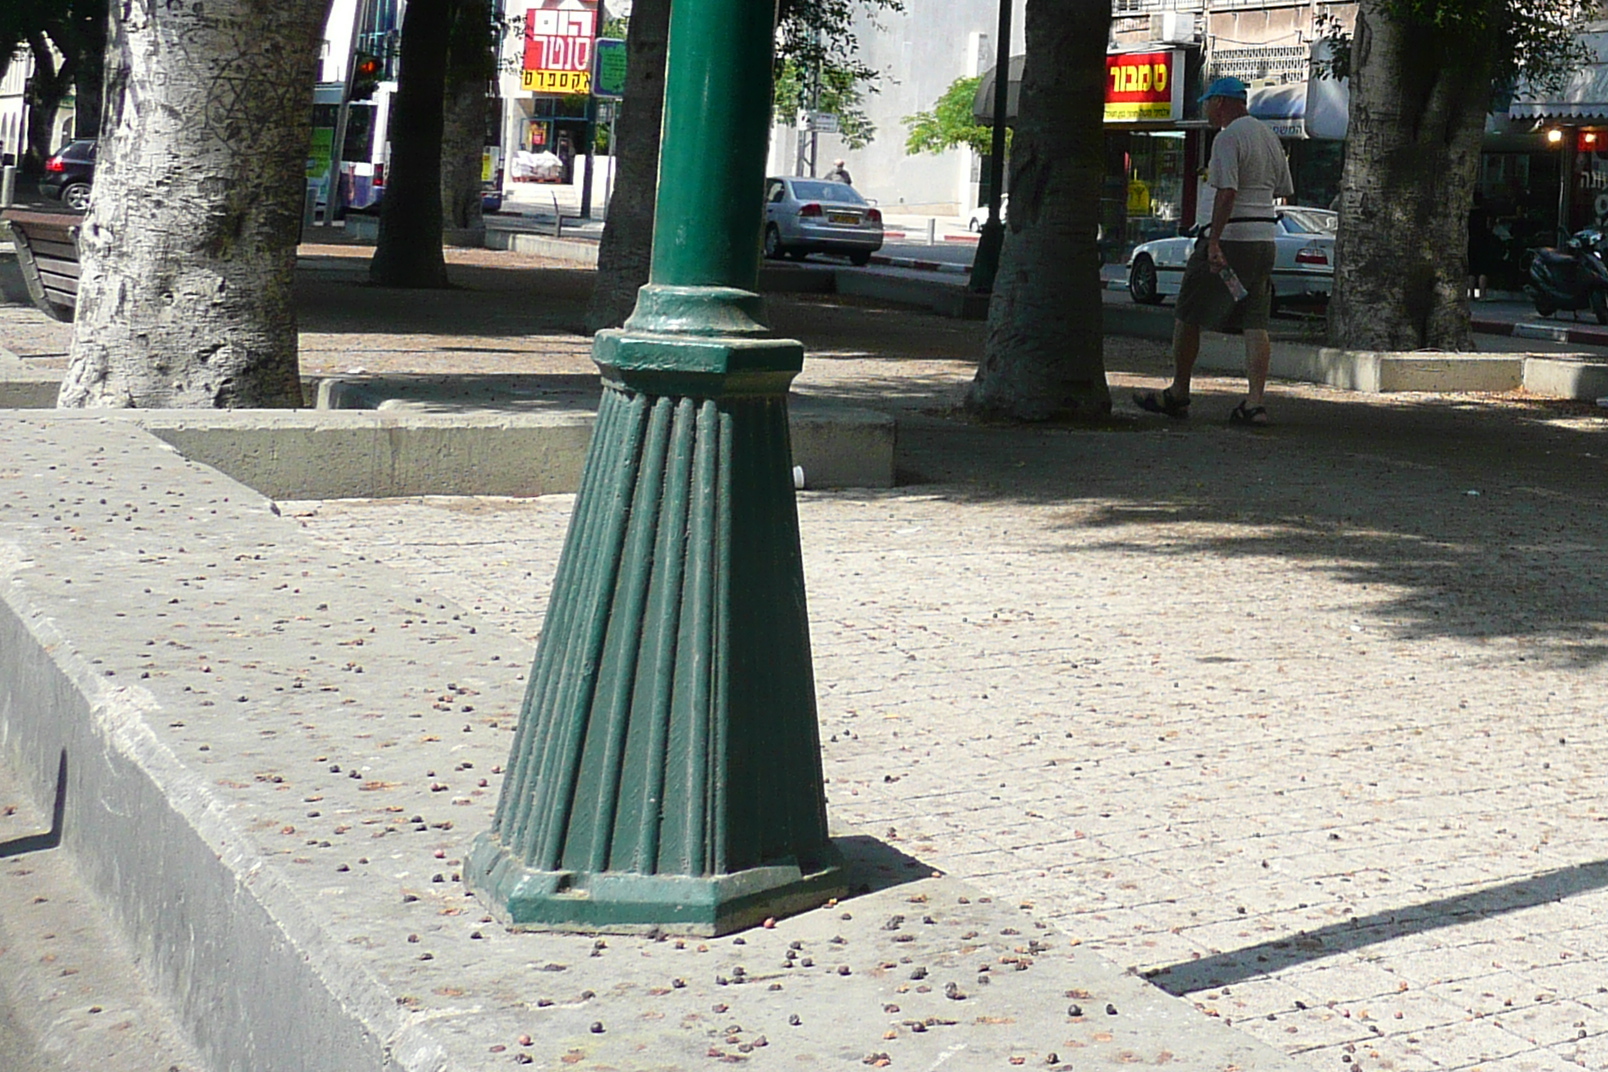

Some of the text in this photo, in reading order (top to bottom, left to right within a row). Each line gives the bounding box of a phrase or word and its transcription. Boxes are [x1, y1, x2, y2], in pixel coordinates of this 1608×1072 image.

[534, 9, 593, 37] הום
[533, 36, 591, 71] סנטר
[1110, 63, 1168, 93] טמבור
